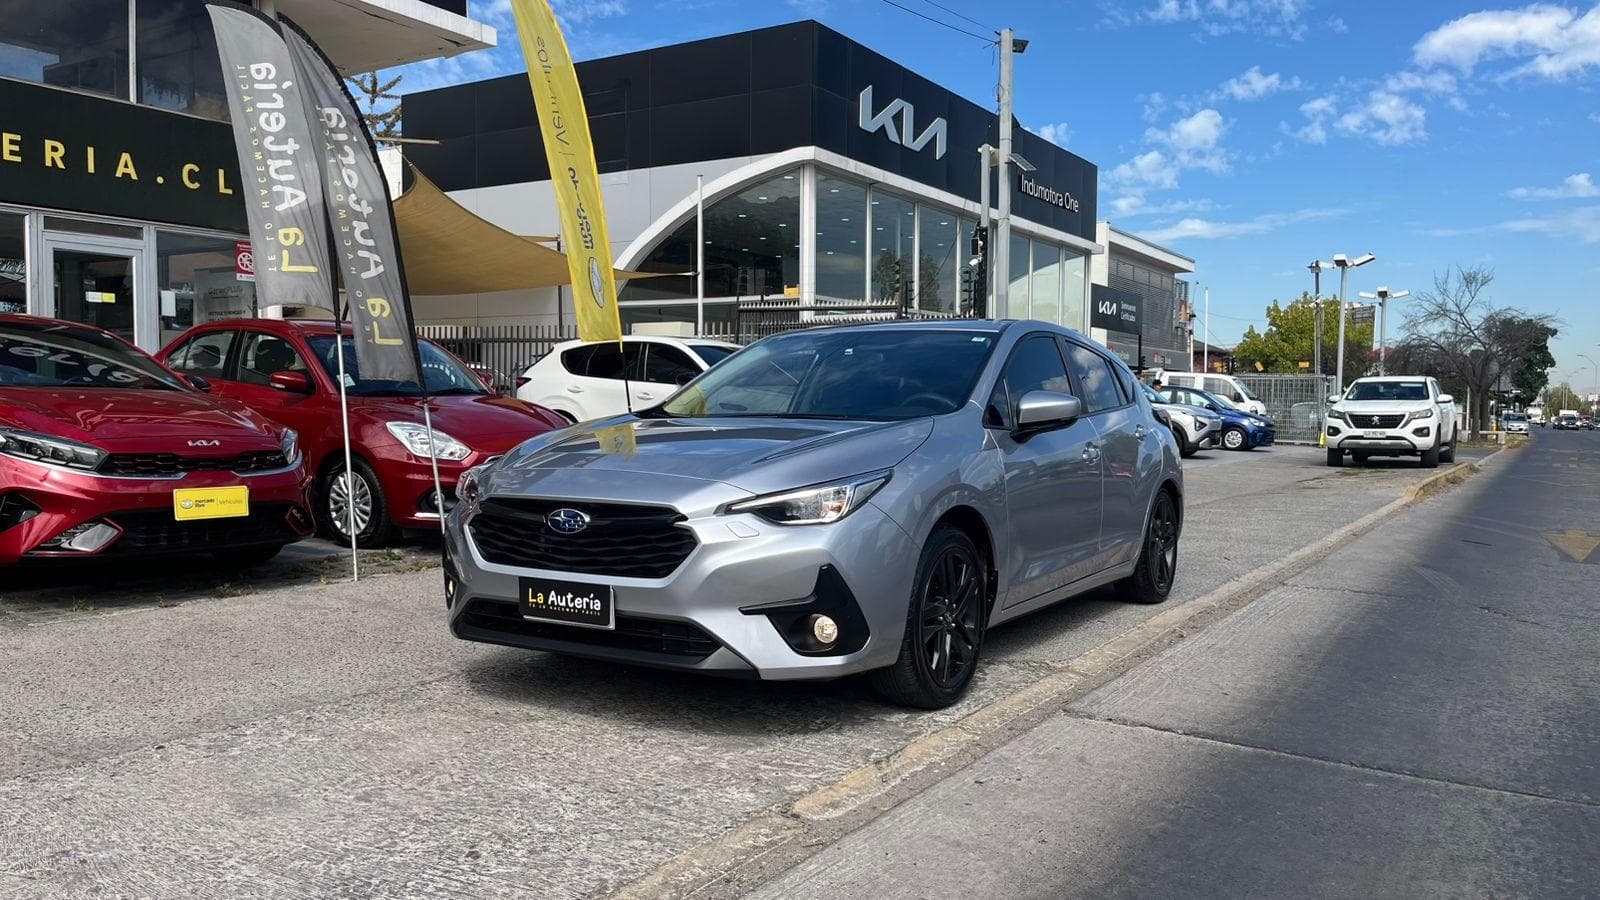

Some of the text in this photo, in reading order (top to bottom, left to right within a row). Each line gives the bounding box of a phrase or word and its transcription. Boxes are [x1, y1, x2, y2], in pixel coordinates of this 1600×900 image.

[1021, 174, 1079, 213] Indumotora One
[528, 587, 601, 611] La Autería
